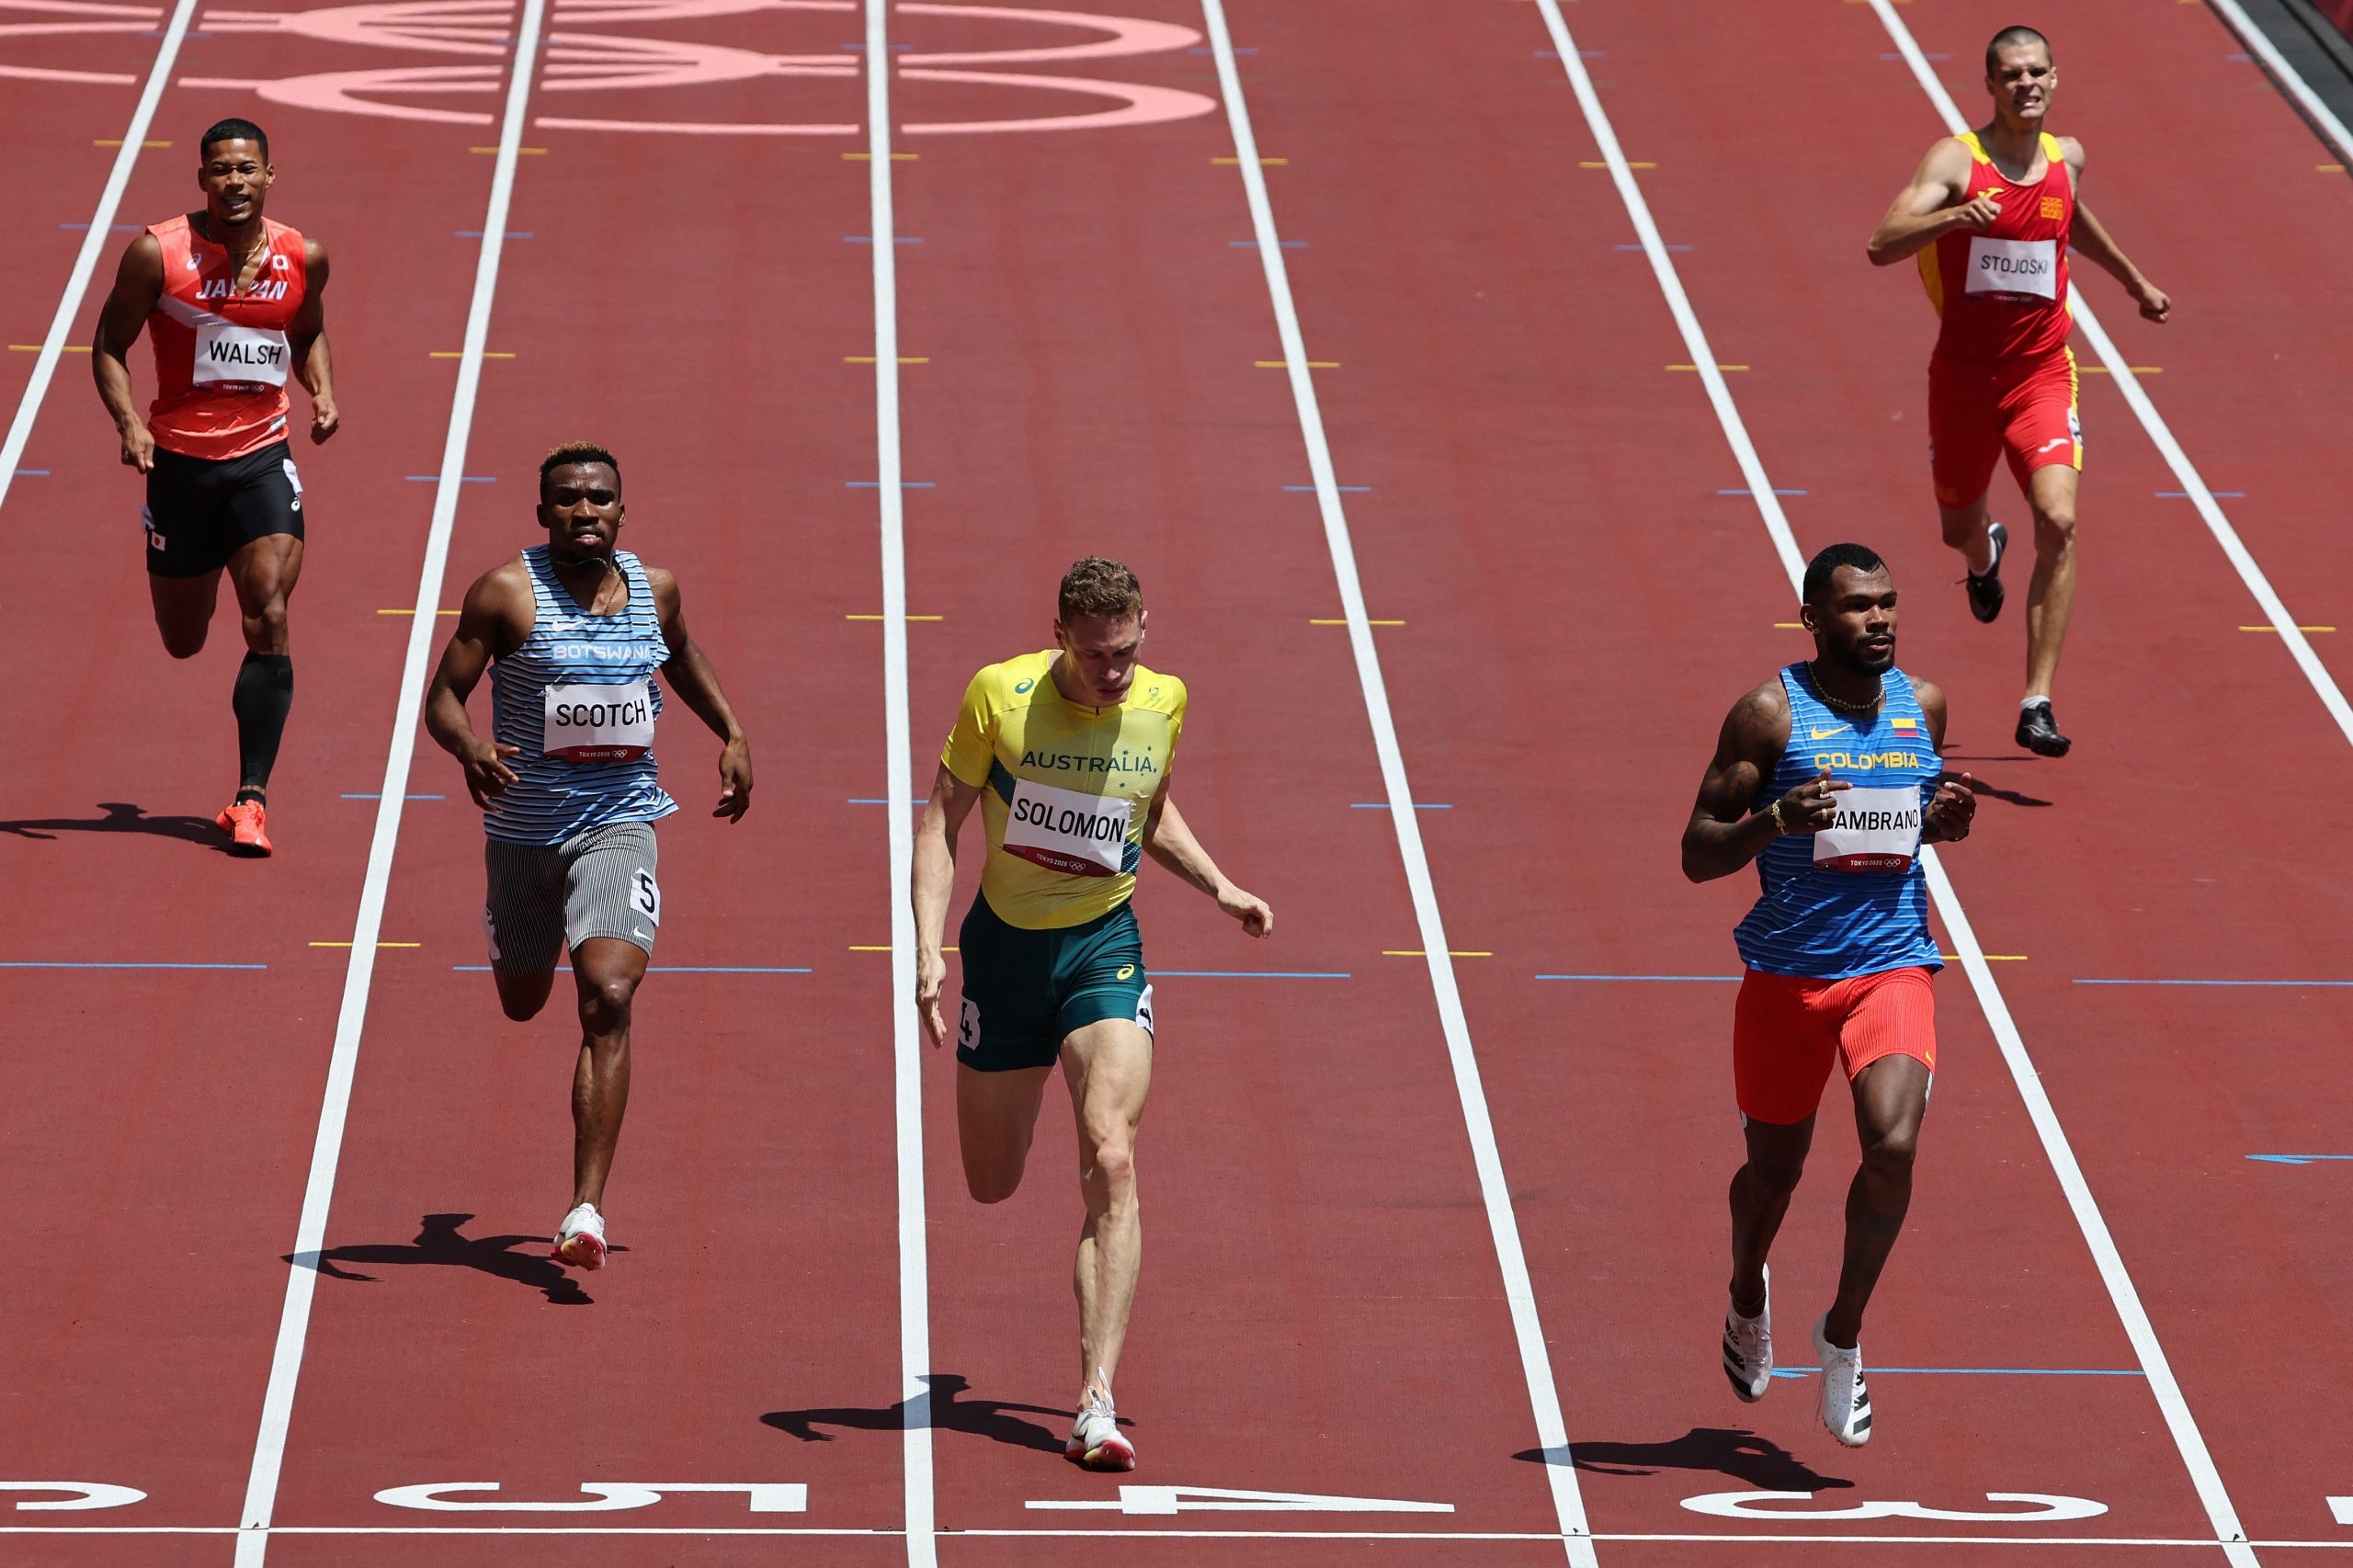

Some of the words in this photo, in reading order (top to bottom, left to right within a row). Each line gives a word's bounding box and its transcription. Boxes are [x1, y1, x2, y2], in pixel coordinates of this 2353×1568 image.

[209, 340, 283, 365] WALSH
[555, 699, 647, 728] SCOTCH
[1019, 750, 1154, 772] AUSTRALIA
[1814, 751, 1920, 770] COLOMBIA
[1014, 797, 1126, 843] SOLOMON
[1834, 809, 1918, 831] AMBRANO
[1036, 852, 1054, 864] TOKYO
[1053, 858, 1068, 868] 2020
[639, 872, 655, 914] 5
[960, 1001, 972, 1042] 4
[373, 1482, 807, 1513] 5
[1025, 1484, 1455, 1515] 4
[1679, 1490, 2109, 1522] 3
